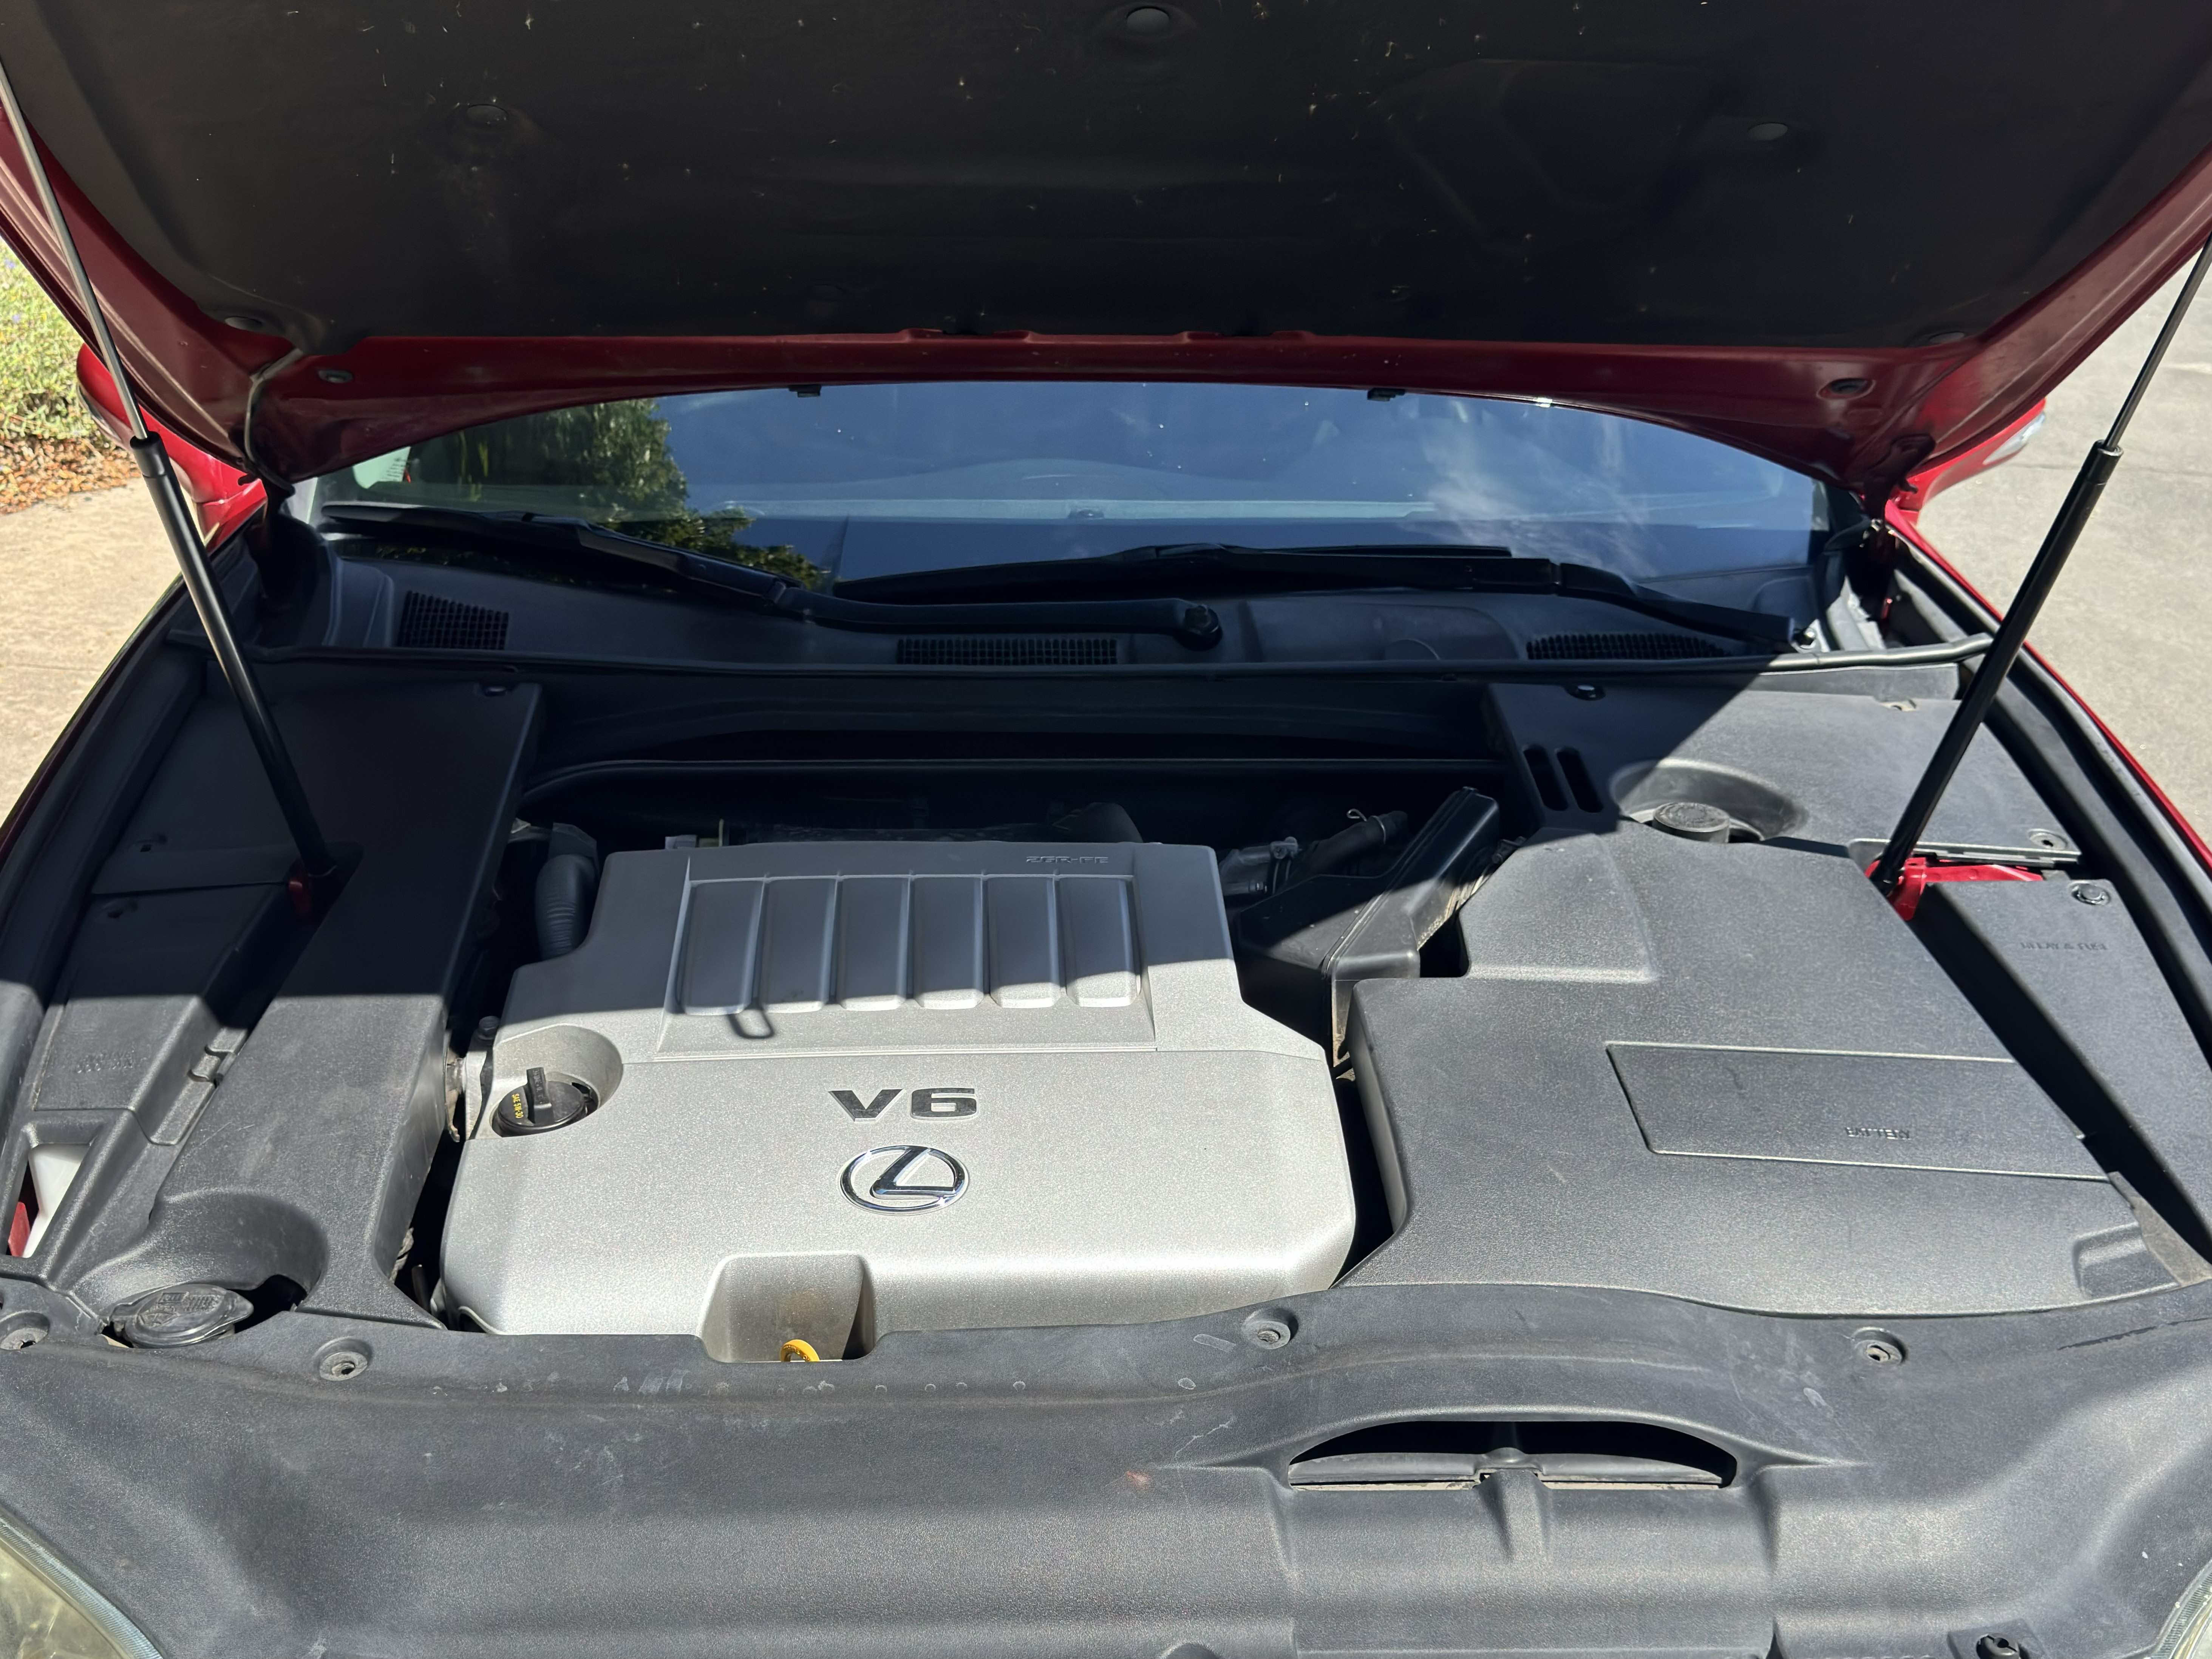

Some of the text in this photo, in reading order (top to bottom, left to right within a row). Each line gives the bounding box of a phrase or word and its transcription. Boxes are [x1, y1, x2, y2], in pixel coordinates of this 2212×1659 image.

[1026, 855, 1109, 864] 2GR-FE
[512, 1093, 524, 1118] SAE 5W-30
[828, 1087, 979, 1122] V6
